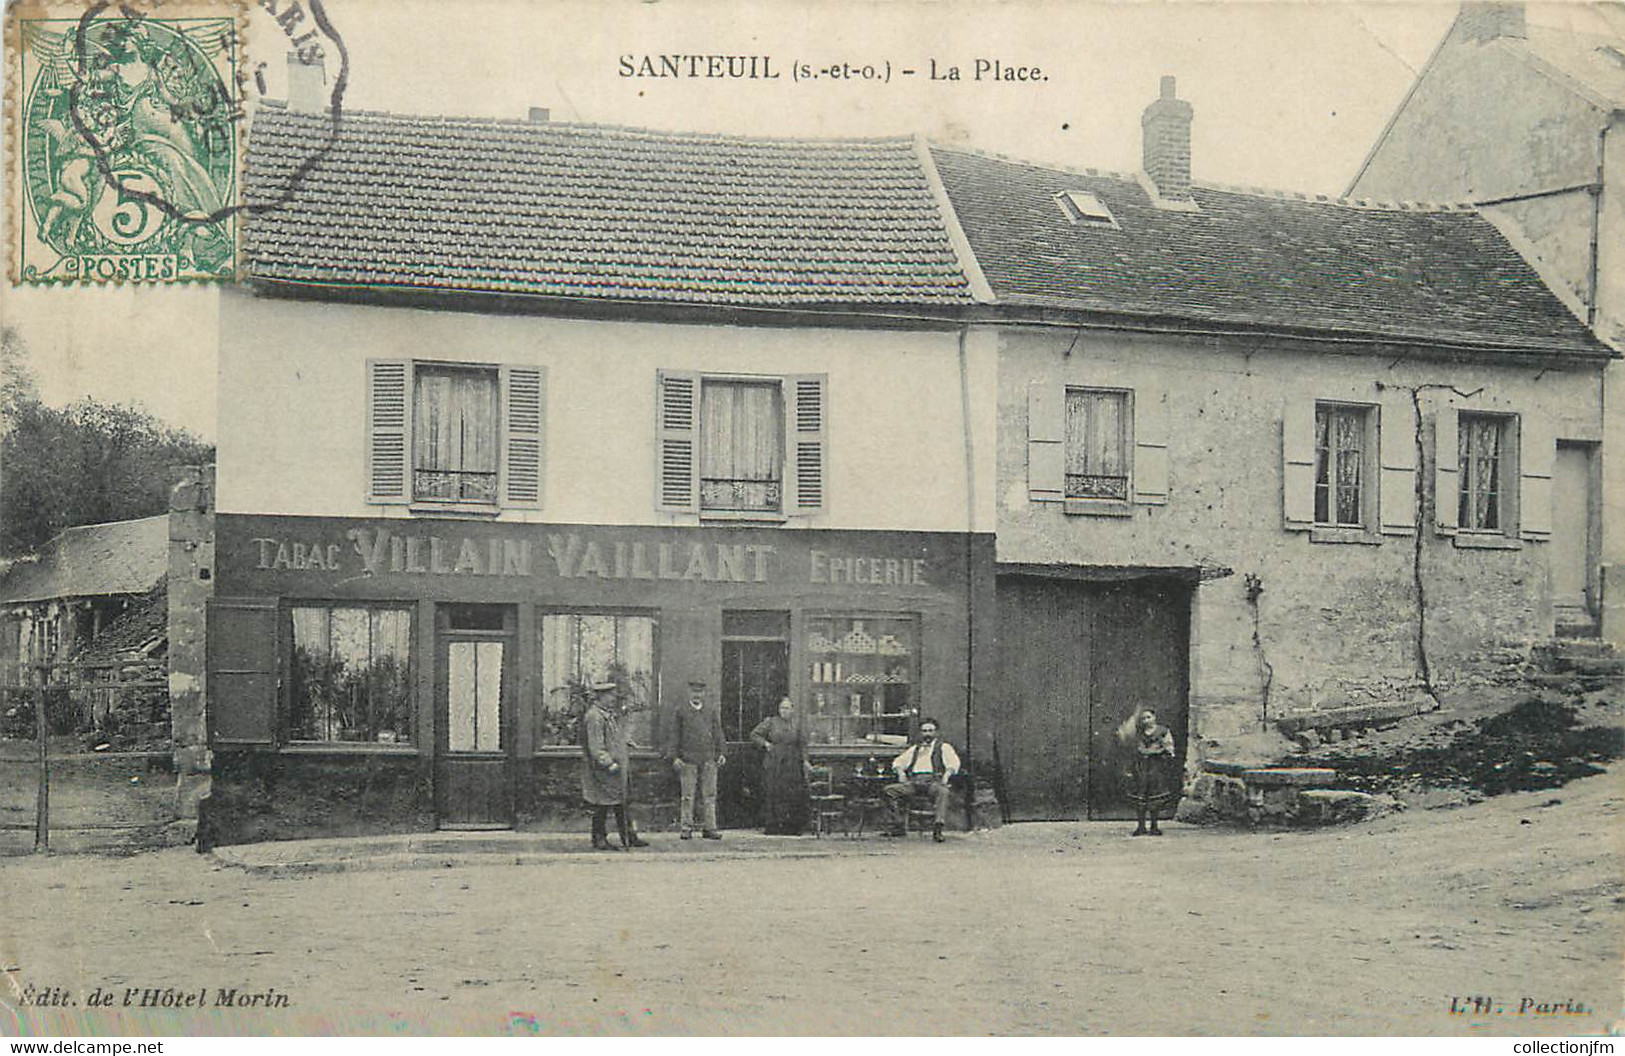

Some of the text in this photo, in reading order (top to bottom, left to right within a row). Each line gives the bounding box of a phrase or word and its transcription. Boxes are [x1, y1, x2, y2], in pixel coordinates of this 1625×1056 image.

[619, 54, 780, 79] SANTEUIL
[930, 58, 961, 81] La
[974, 59, 1049, 82] Place.
[112, 173, 148, 238] 5
[83, 257, 174, 279] POSTES
[251, 528, 927, 585] TABAC VILLAIN VAILLANT EPICERIE
[87, 987, 114, 1007] de
[123, 987, 206, 1008] l'Hôtel
[215, 987, 289, 1008] Morin
